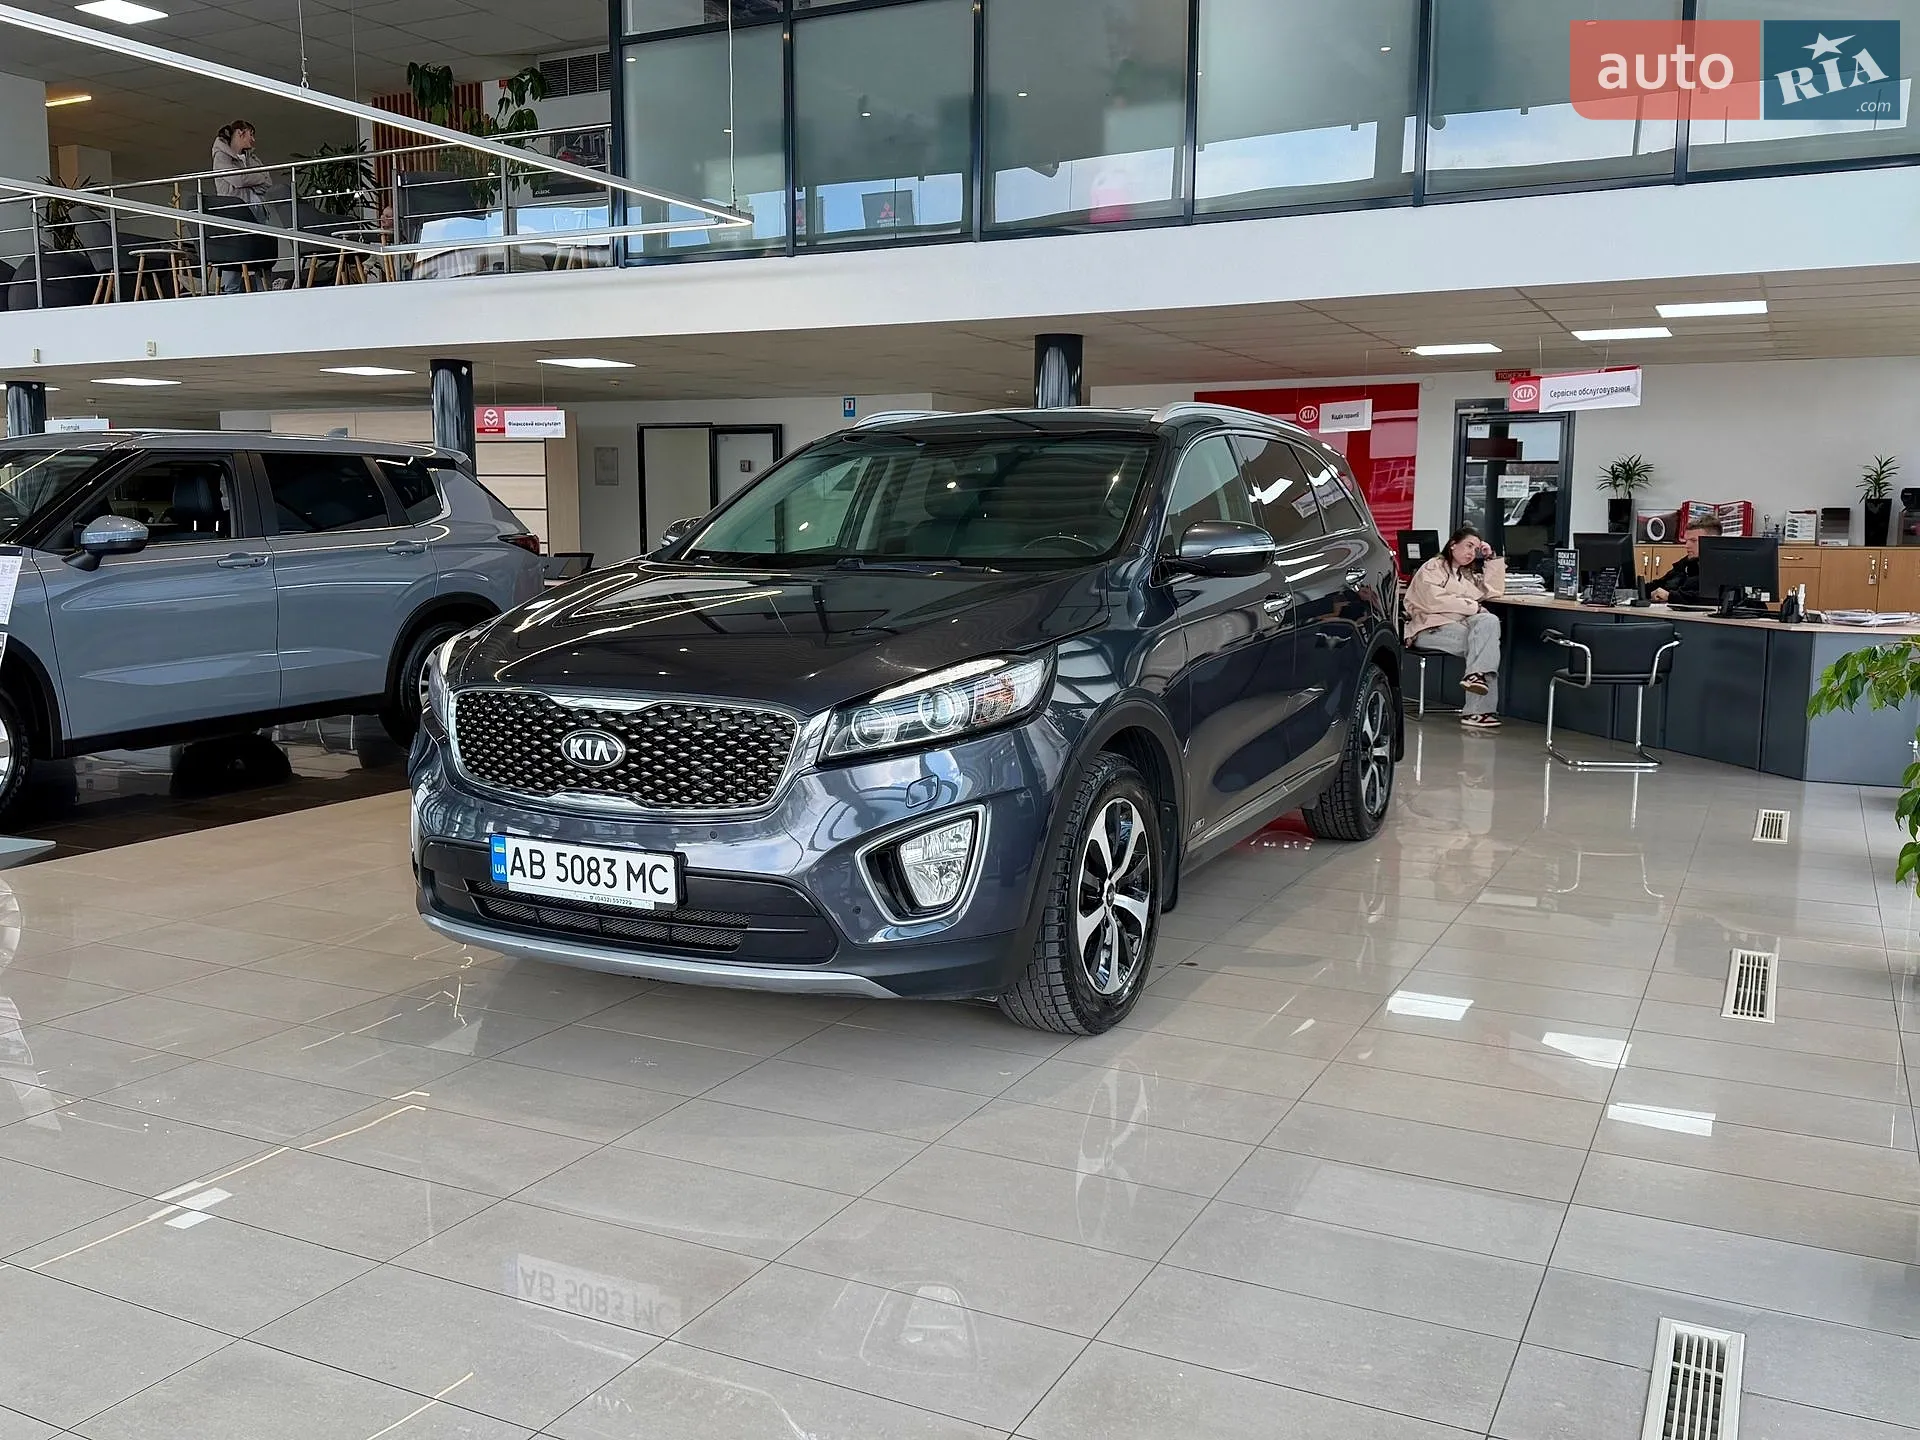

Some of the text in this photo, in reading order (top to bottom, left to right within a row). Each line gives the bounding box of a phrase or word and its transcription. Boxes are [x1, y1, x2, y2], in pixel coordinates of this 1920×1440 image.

[1550, 386, 1630, 398] Сервісне обслуговування
[570, 738, 611, 762] KIA
[494, 864, 506, 875] UA
[509, 846, 669, 895] AB 5083 MC
